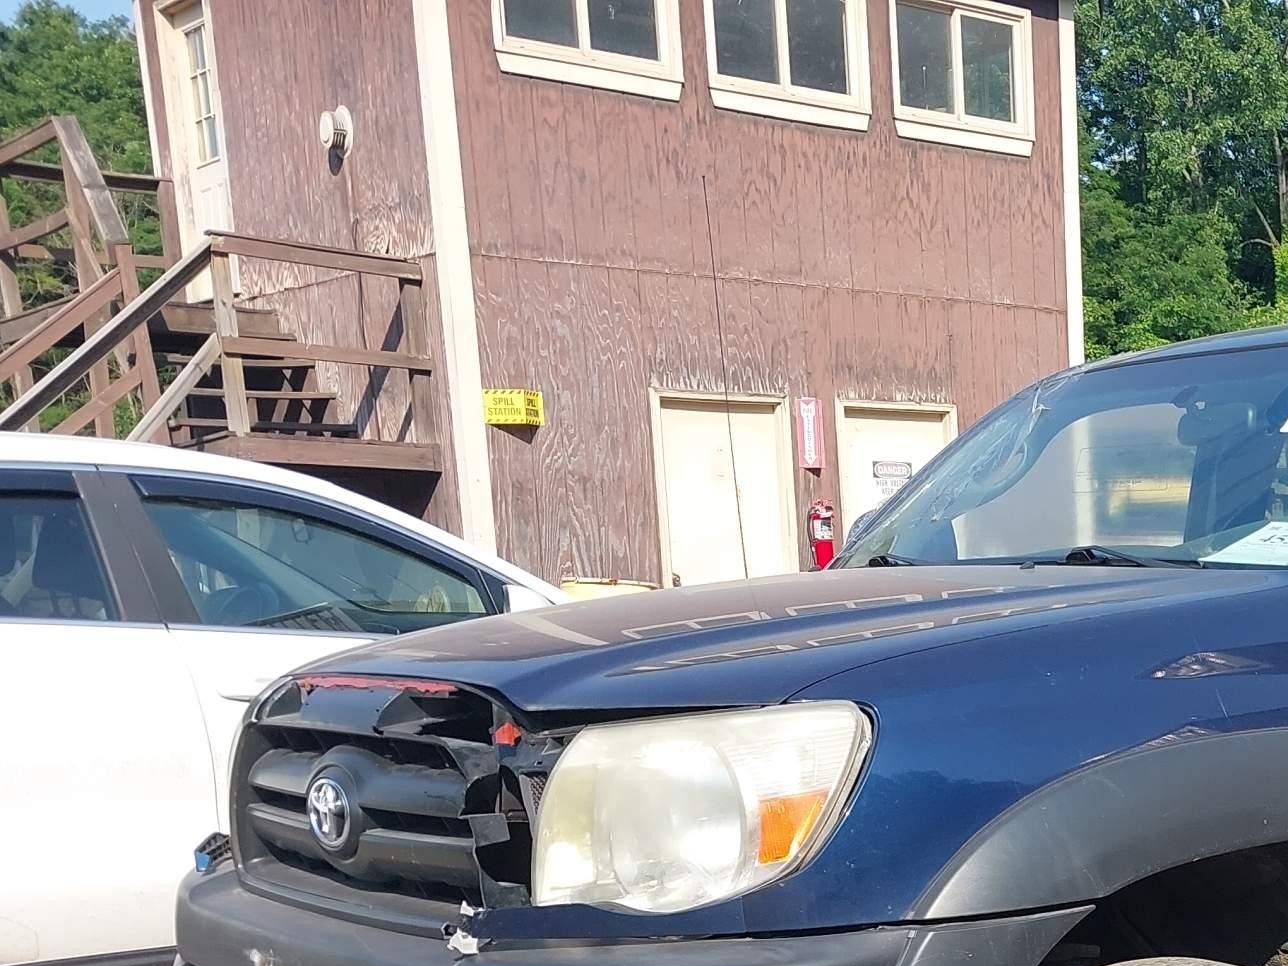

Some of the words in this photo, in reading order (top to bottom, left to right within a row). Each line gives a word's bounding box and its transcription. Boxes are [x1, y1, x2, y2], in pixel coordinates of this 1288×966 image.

[492, 397, 515, 406] SPILL
[487, 407, 522, 417] STATION
[878, 465, 907, 475] DANGER
